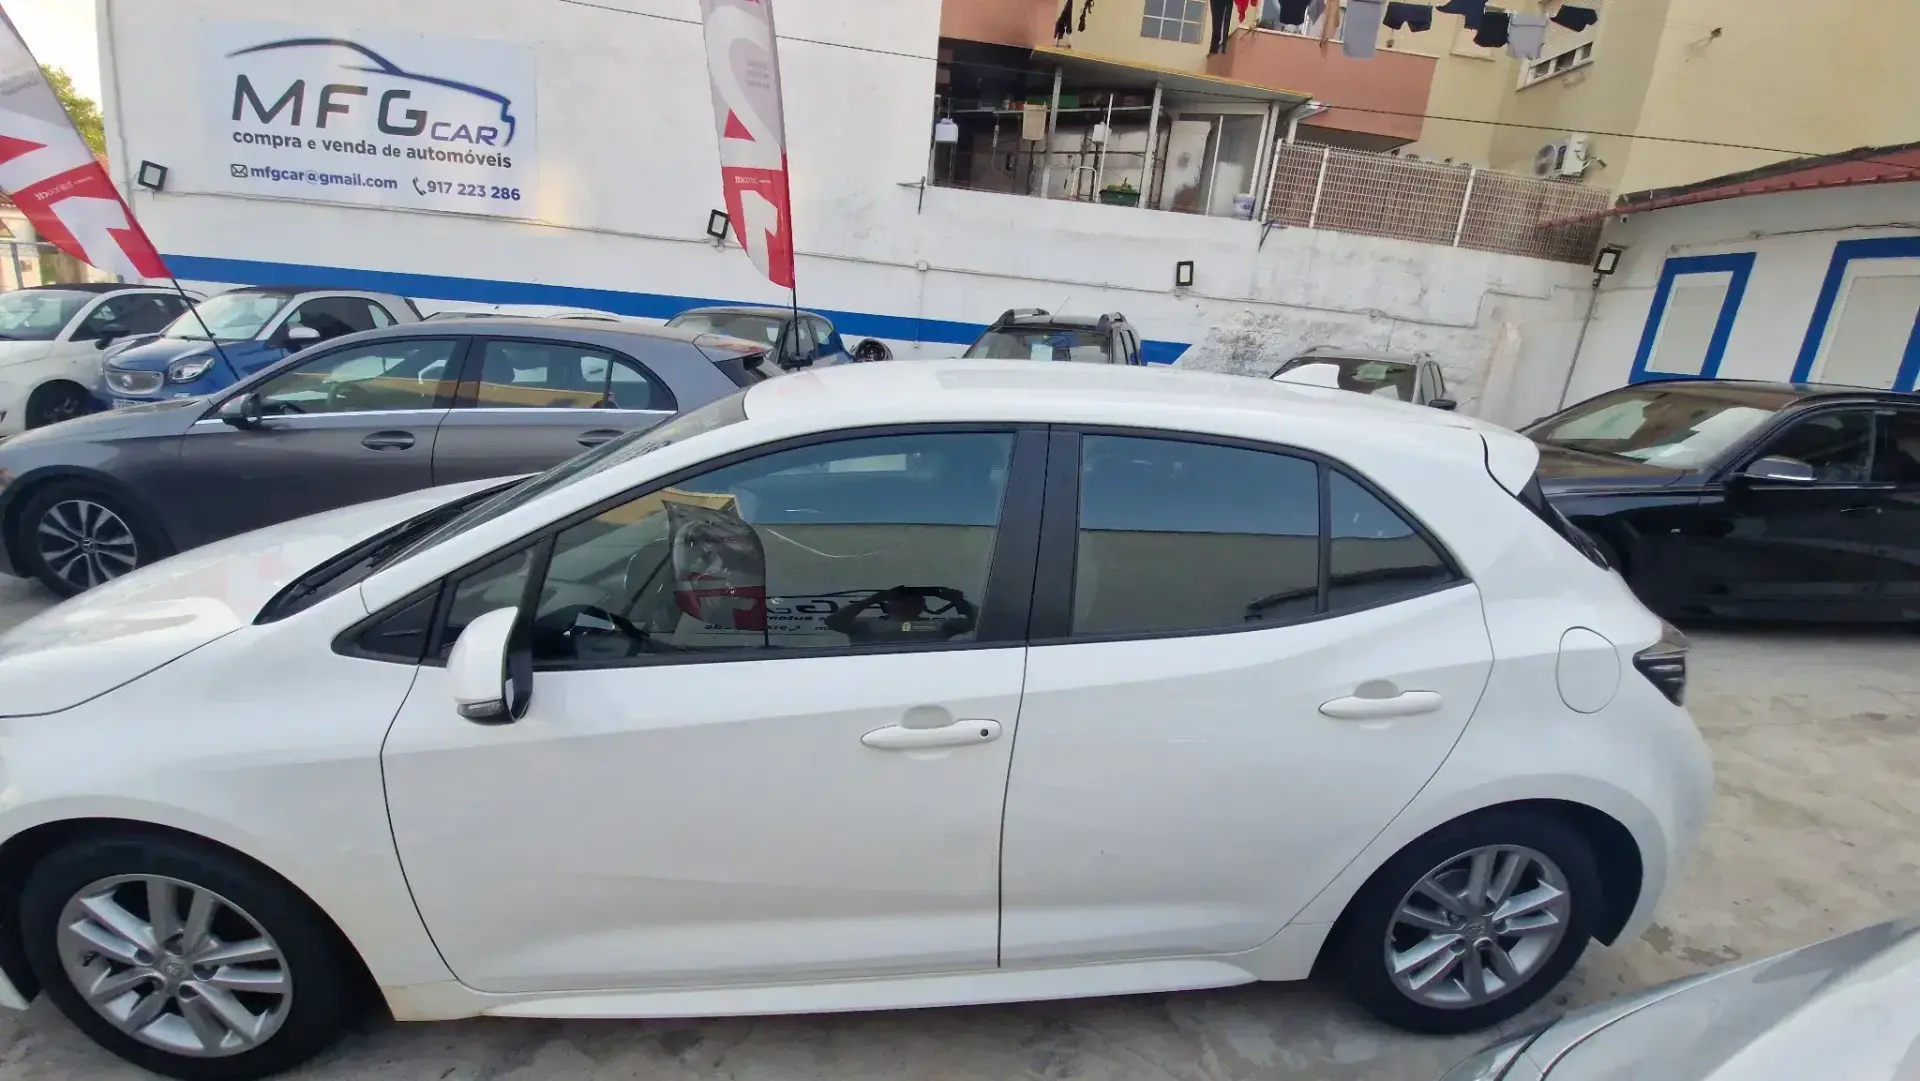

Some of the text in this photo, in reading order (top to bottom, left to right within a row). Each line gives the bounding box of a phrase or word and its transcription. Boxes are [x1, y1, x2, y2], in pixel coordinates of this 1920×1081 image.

[232, 74, 499, 147] MFG CAR
[232, 131, 512, 169] compra e venda de automóveis
[250, 165, 398, 189] mfgcar@gmail.com
[427, 180, 521, 201] 917 223 286
